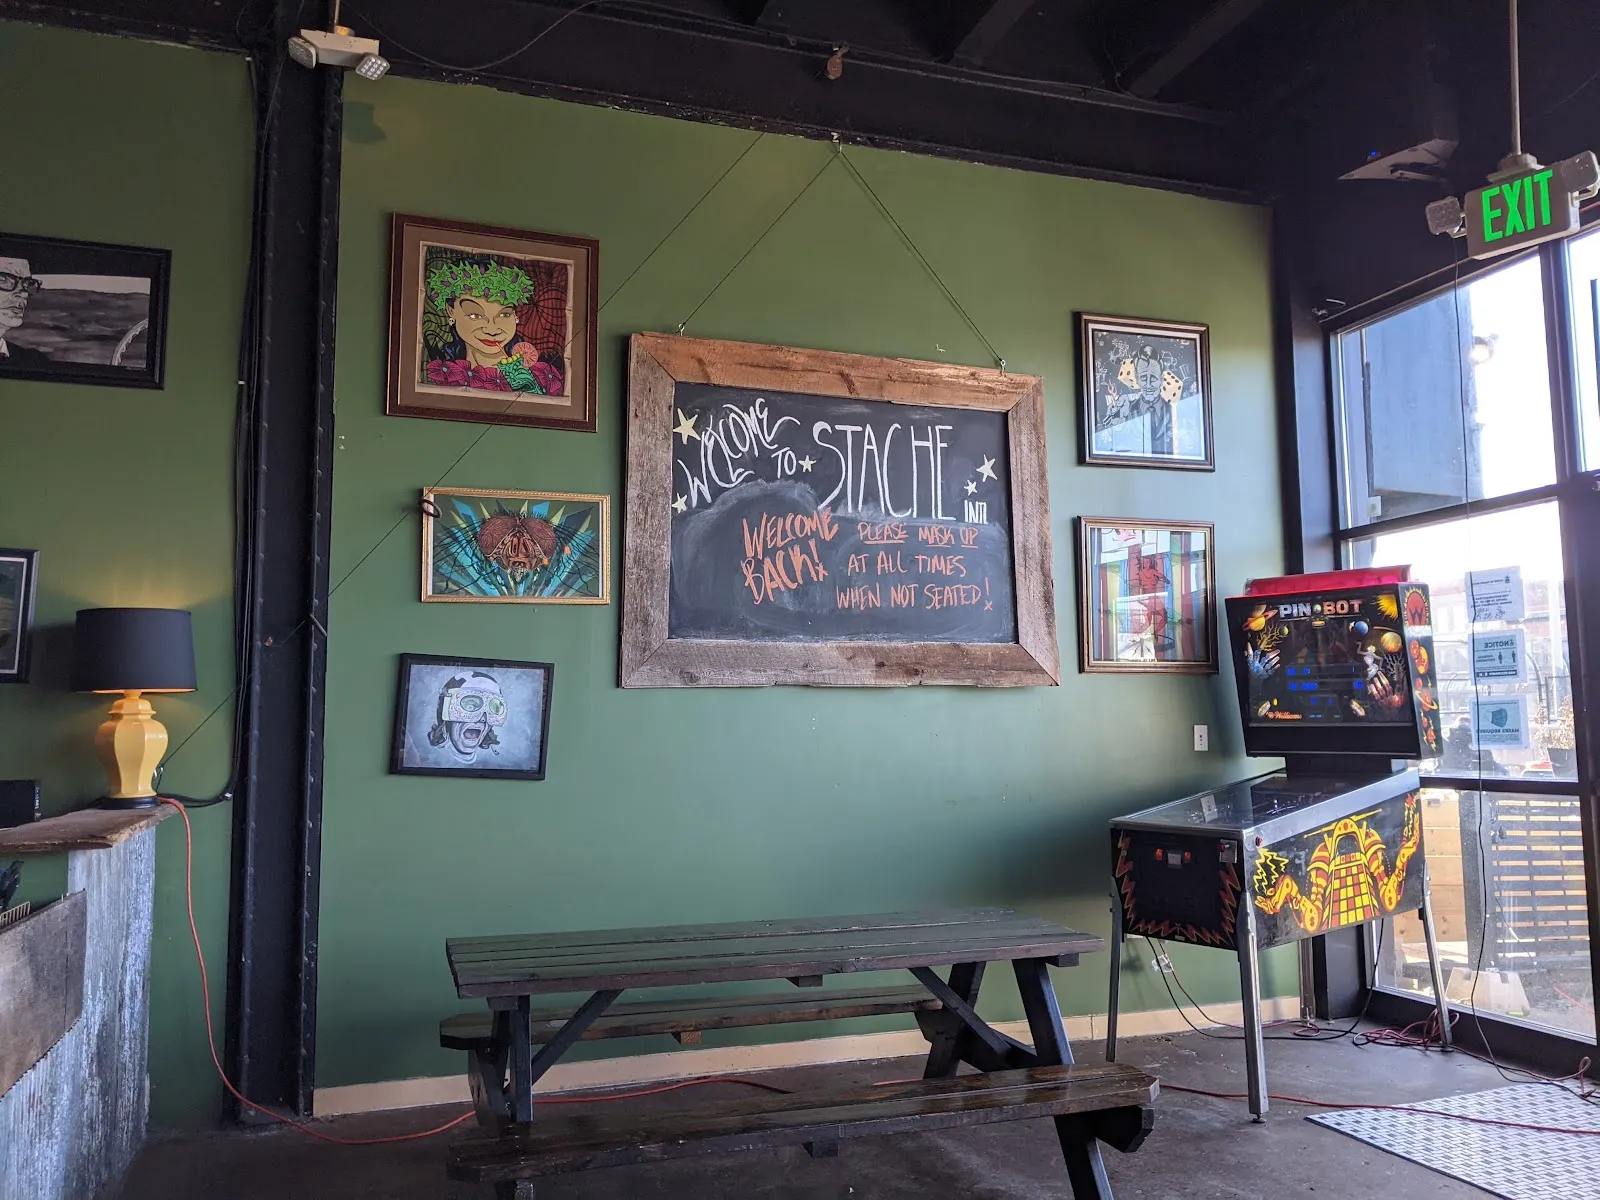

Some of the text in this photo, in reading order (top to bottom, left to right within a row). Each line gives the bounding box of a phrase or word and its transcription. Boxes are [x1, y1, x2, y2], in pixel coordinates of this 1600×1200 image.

[1481, 170, 1553, 242] EXIT
[677, 397, 801, 509] WELCOME
[771, 446, 797, 479] TO
[812, 420, 957, 520] STACHE
[742, 506, 840, 560] WELCOME
[857, 521, 979, 546] PLEASE MASK UP
[847, 550, 967, 578] AT ALL TIMES
[836, 582, 881, 611] WHEN
[890, 582, 919, 608] NOT
[1278, 599, 1363, 618] PIN BOT
